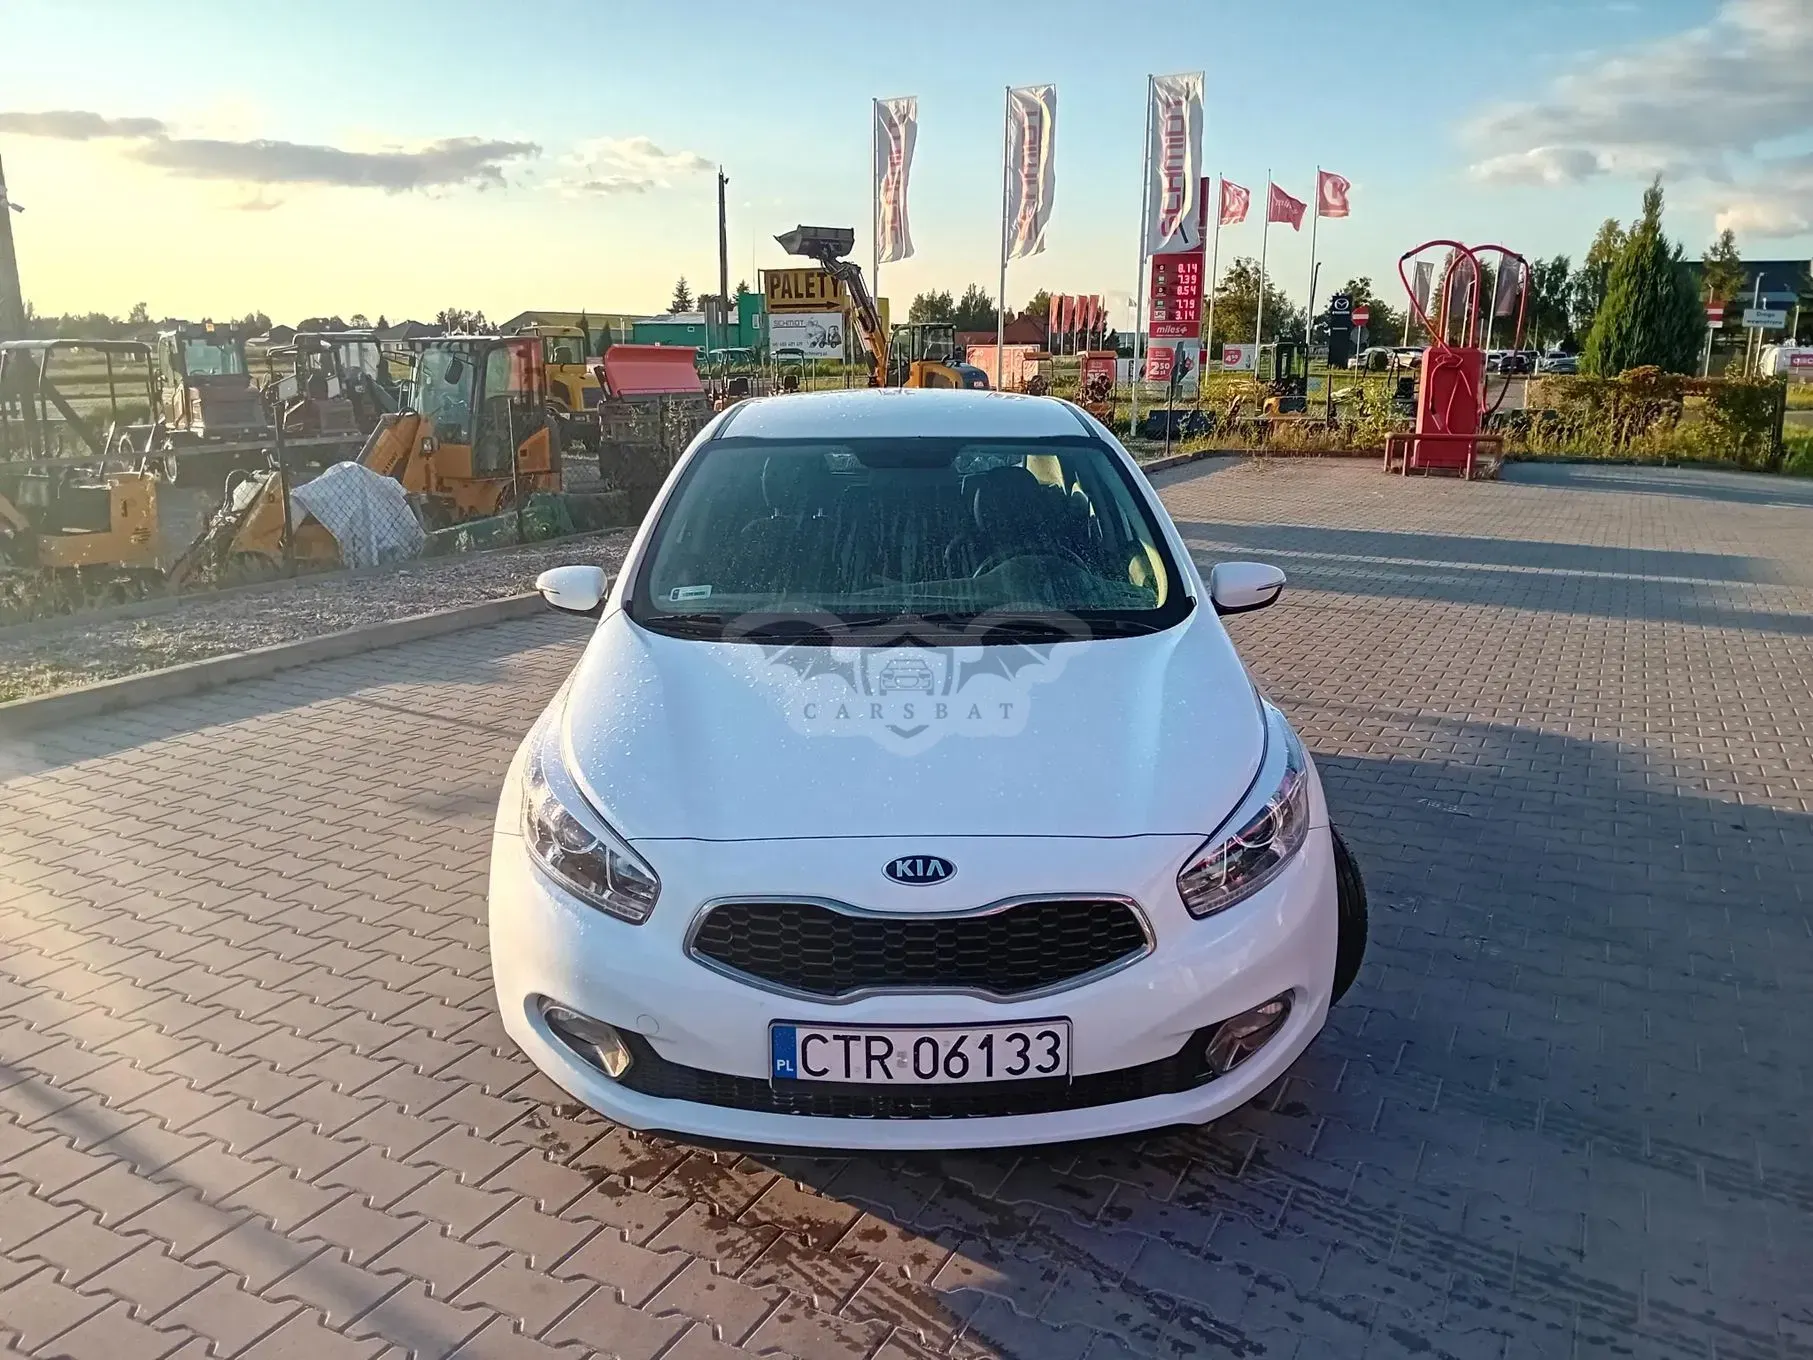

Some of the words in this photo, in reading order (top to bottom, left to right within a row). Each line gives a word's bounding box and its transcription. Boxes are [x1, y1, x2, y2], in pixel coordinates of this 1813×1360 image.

[769, 271, 839, 299] PALETY
[1175, 311, 1194, 320] 3.14
[896, 859, 946, 877] KIA
[801, 1033, 895, 1080] CTR
[912, 1030, 1062, 1080] 06133
[776, 1059, 794, 1072] PL
